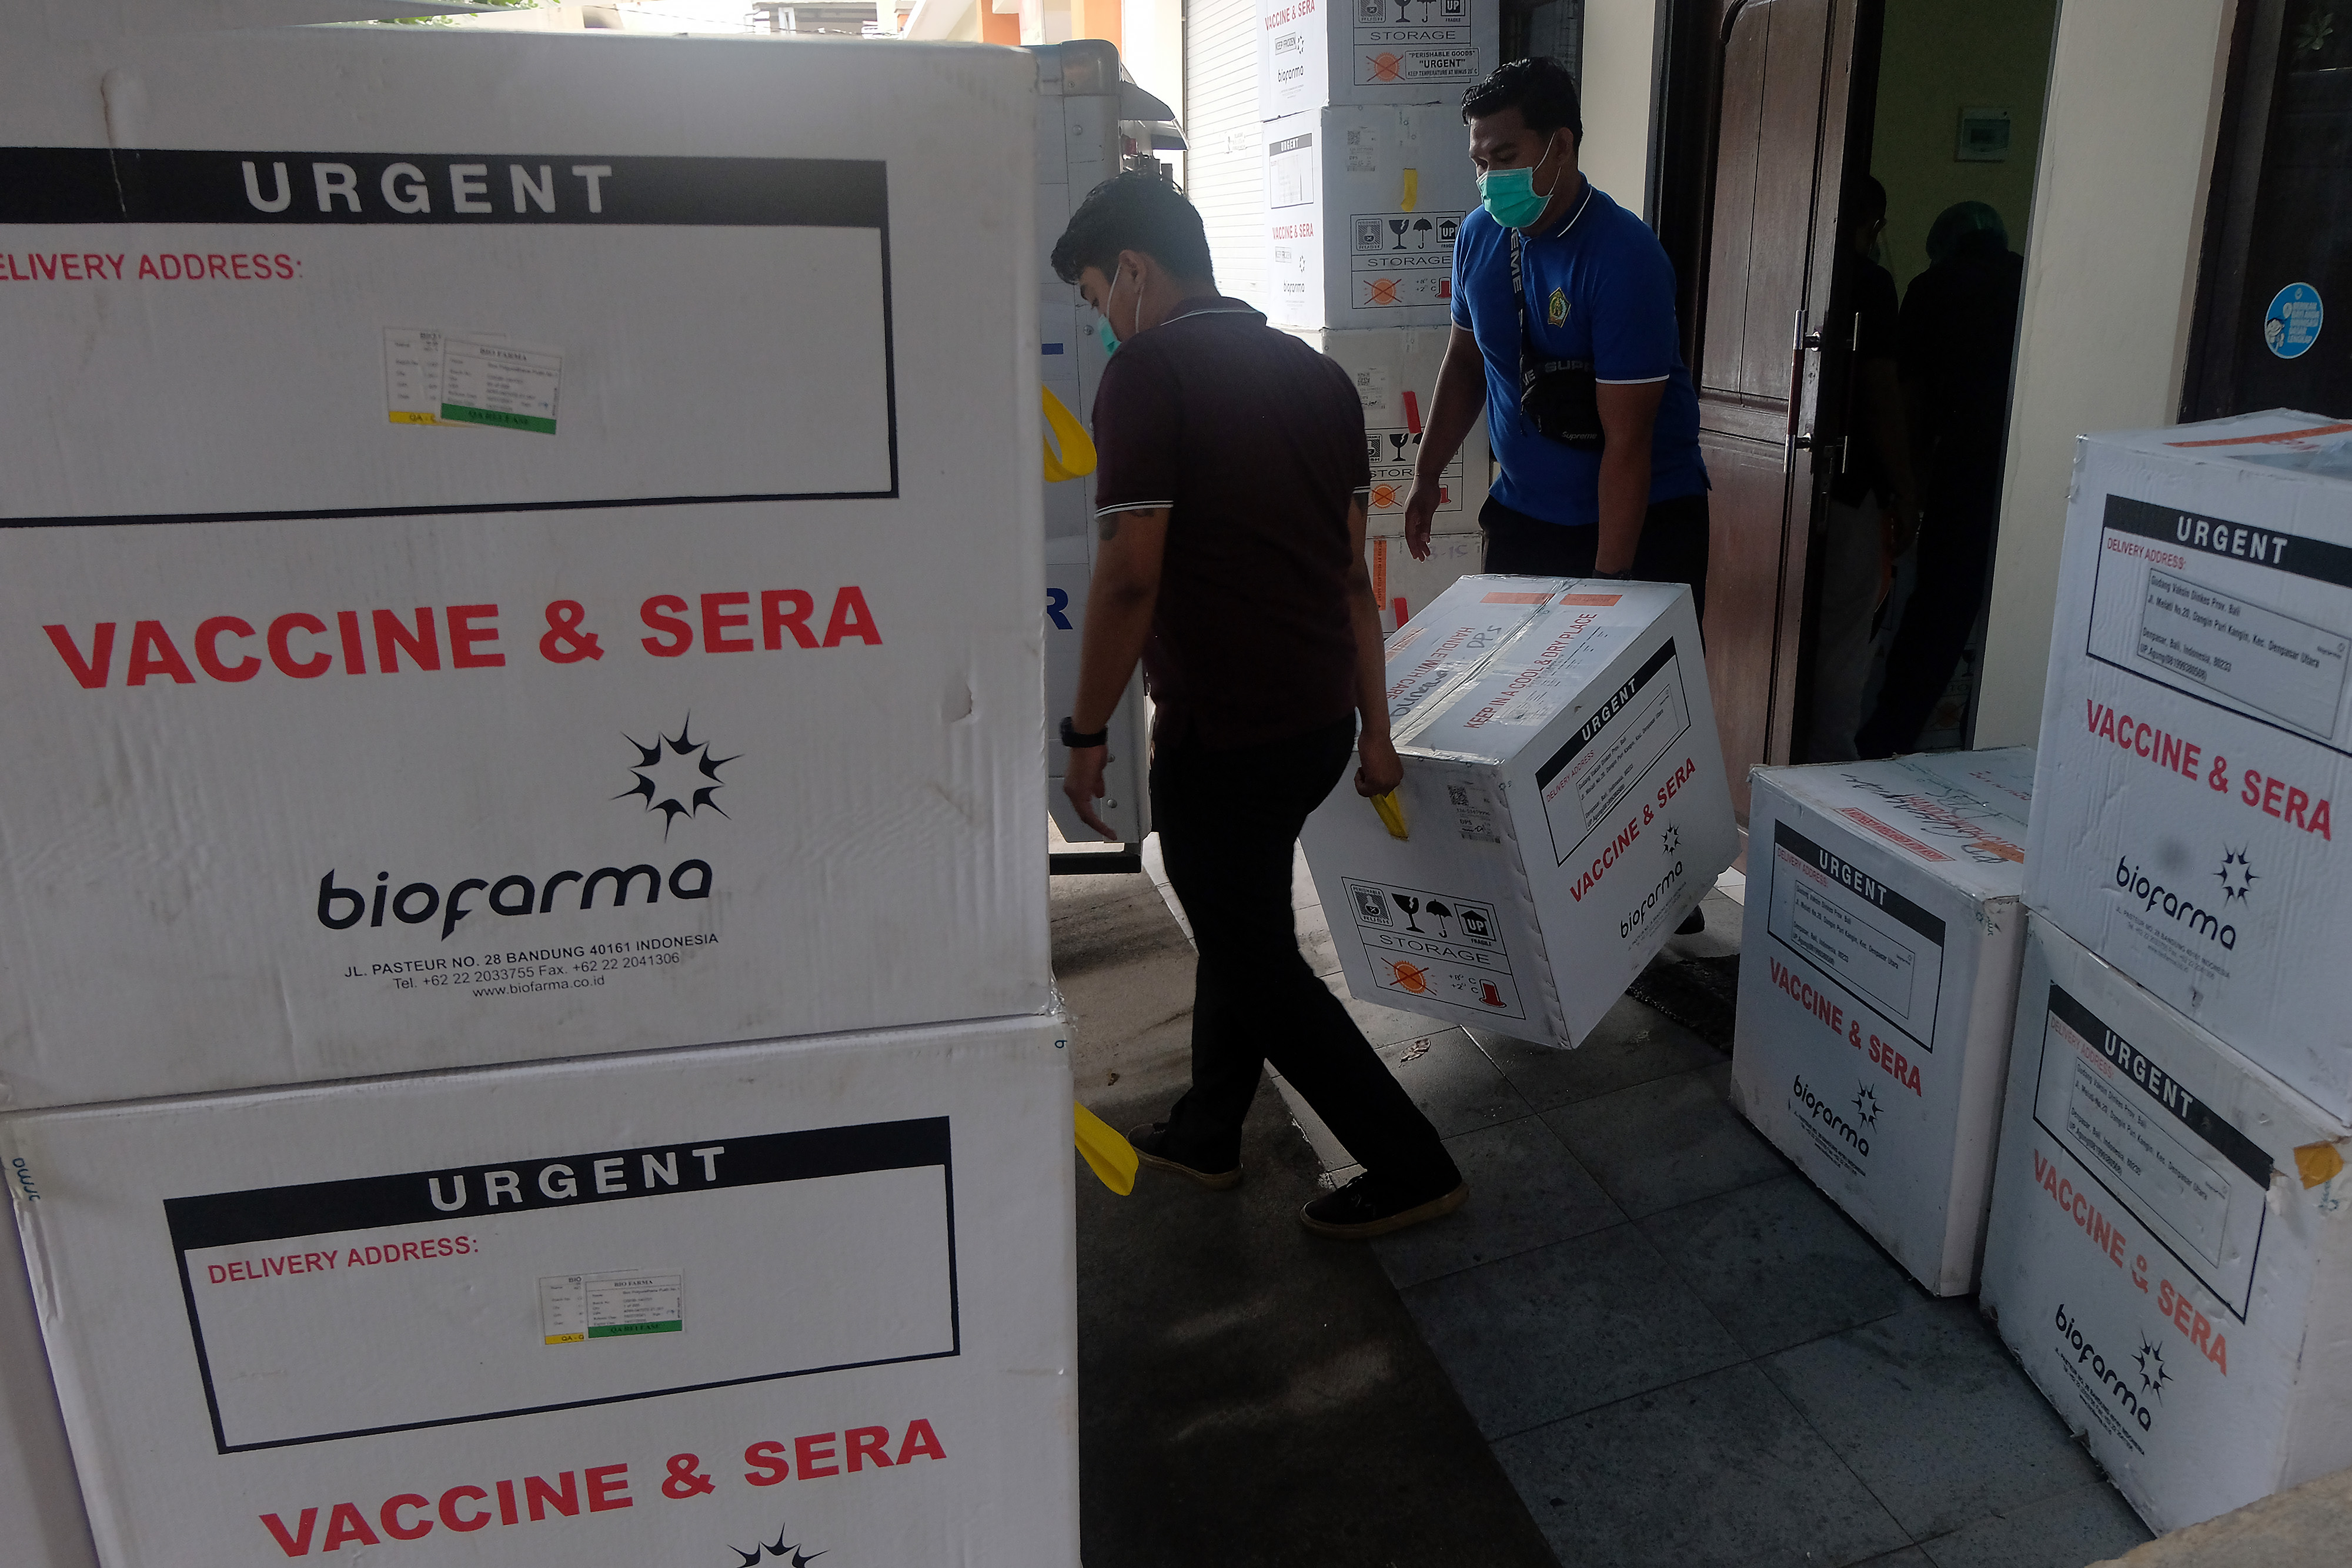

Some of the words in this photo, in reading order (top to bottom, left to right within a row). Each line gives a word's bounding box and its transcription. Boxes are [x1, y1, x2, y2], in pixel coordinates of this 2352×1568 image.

[1265, 8, 1290, 31] VACCINE
[1292, 5, 1296, 19] &
[1298, 0, 1315, 17] SERA
[1447, 1, 1458, 10] UP
[1283, 37, 1296, 48] FROZEN
[1371, 31, 1456, 41] STORAGE
[1278, 65, 1304, 84] biofarma
[1419, 59, 1465, 68] "URGENT"
[1281, 138, 1298, 152] URGENT
[242, 161, 612, 214] URGENT
[1272, 225, 1292, 240] VACCINE
[1294, 225, 1298, 238] &
[1299, 223, 1314, 238] SERA
[1442, 228, 1454, 236] UP
[138, 254, 303, 280] ADDRESS:
[1368, 256, 1451, 266] STORAGE
[1562, 431, 1598, 440] Supreme
[1370, 467, 1448, 477] STORE
[2107, 537, 2144, 558] DELIVERY
[2145, 549, 2186, 570] ADDRESS:
[2176, 516, 2288, 564] URGENT
[42, 604, 506, 689] VACCINE
[539, 600, 604, 664] &
[640, 586, 883, 657] SERA
[1430, 627, 1475, 658] HANDLE
[1466, 625, 1502, 648] DPS
[1407, 659, 1441, 678] WITH
[1463, 707, 1497, 729] KEEP
[1489, 697, 1511, 706] IN
[1509, 667, 1545, 690] COOL
[1541, 641, 1569, 658] DRY
[1558, 613, 1598, 639] PLACE
[1581, 678, 1636, 741] URGENT
[2087, 698, 2201, 781] VACCINE
[2209, 756, 2229, 794] &
[2241, 769, 2331, 842] SERA
[1546, 773, 1571, 802] DELIVERY
[1570, 817, 1640, 902] VACCINE
[1643, 804, 1654, 825] &
[1657, 757, 1696, 808] SERA
[1819, 849, 1887, 905] URGENT
[317, 859, 713, 941] biofarma
[1621, 861, 1683, 939] biofarma
[2116, 855, 2236, 951] biofarma
[1362, 915, 1389, 925] RUSH
[1466, 918, 1484, 932] UP
[344, 966, 368, 977] JL.
[372, 958, 447, 975] PASTEUR
[452, 956, 480, 968] NO.
[485, 954, 501, 965] 28
[506, 946, 584, 963] BANDUNG
[590, 941, 630, 955] 40161
[636, 934, 719, 951] INDONESIA
[1379, 934, 1491, 965] STORAGE
[1471, 938, 1492, 947] FRAGILE
[393, 978, 417, 990] Tel.
[423, 974, 448, 986] +62
[452, 972, 470, 985] 22
[475, 966, 534, 983] 2033755
[539, 965, 568, 977] Fax.
[573, 961, 597, 972] +62
[602, 958, 618, 970] 22
[623, 952, 681, 968] 2041306
[473, 974, 606, 997] www.biofarma.co.id
[1769, 956, 1843, 1037] VACCINE
[1849, 1020, 1862, 1050] &
[1868, 1035, 1922, 1098] SERA
[2050, 1017, 2080, 1050] DELIVERY
[2104, 1029, 2193, 1118] URGENT
[1793, 1075, 1869, 1157] biofarma
[429, 1146, 725, 1212] URGENT
[208, 1250, 338, 1284] DELIVERY
[348, 1236, 479, 1268] ADDRESS:
[2032, 1149, 2124, 1268] VACCINE
[2130, 1255, 2148, 1294] &
[2157, 1279, 2227, 1378] SERA
[2054, 1303, 2151, 1433] biofarma
[259, 1463, 633, 1558] VACCINE
[661, 1453, 716, 1500] &
[744, 1418, 947, 1487] SERA
